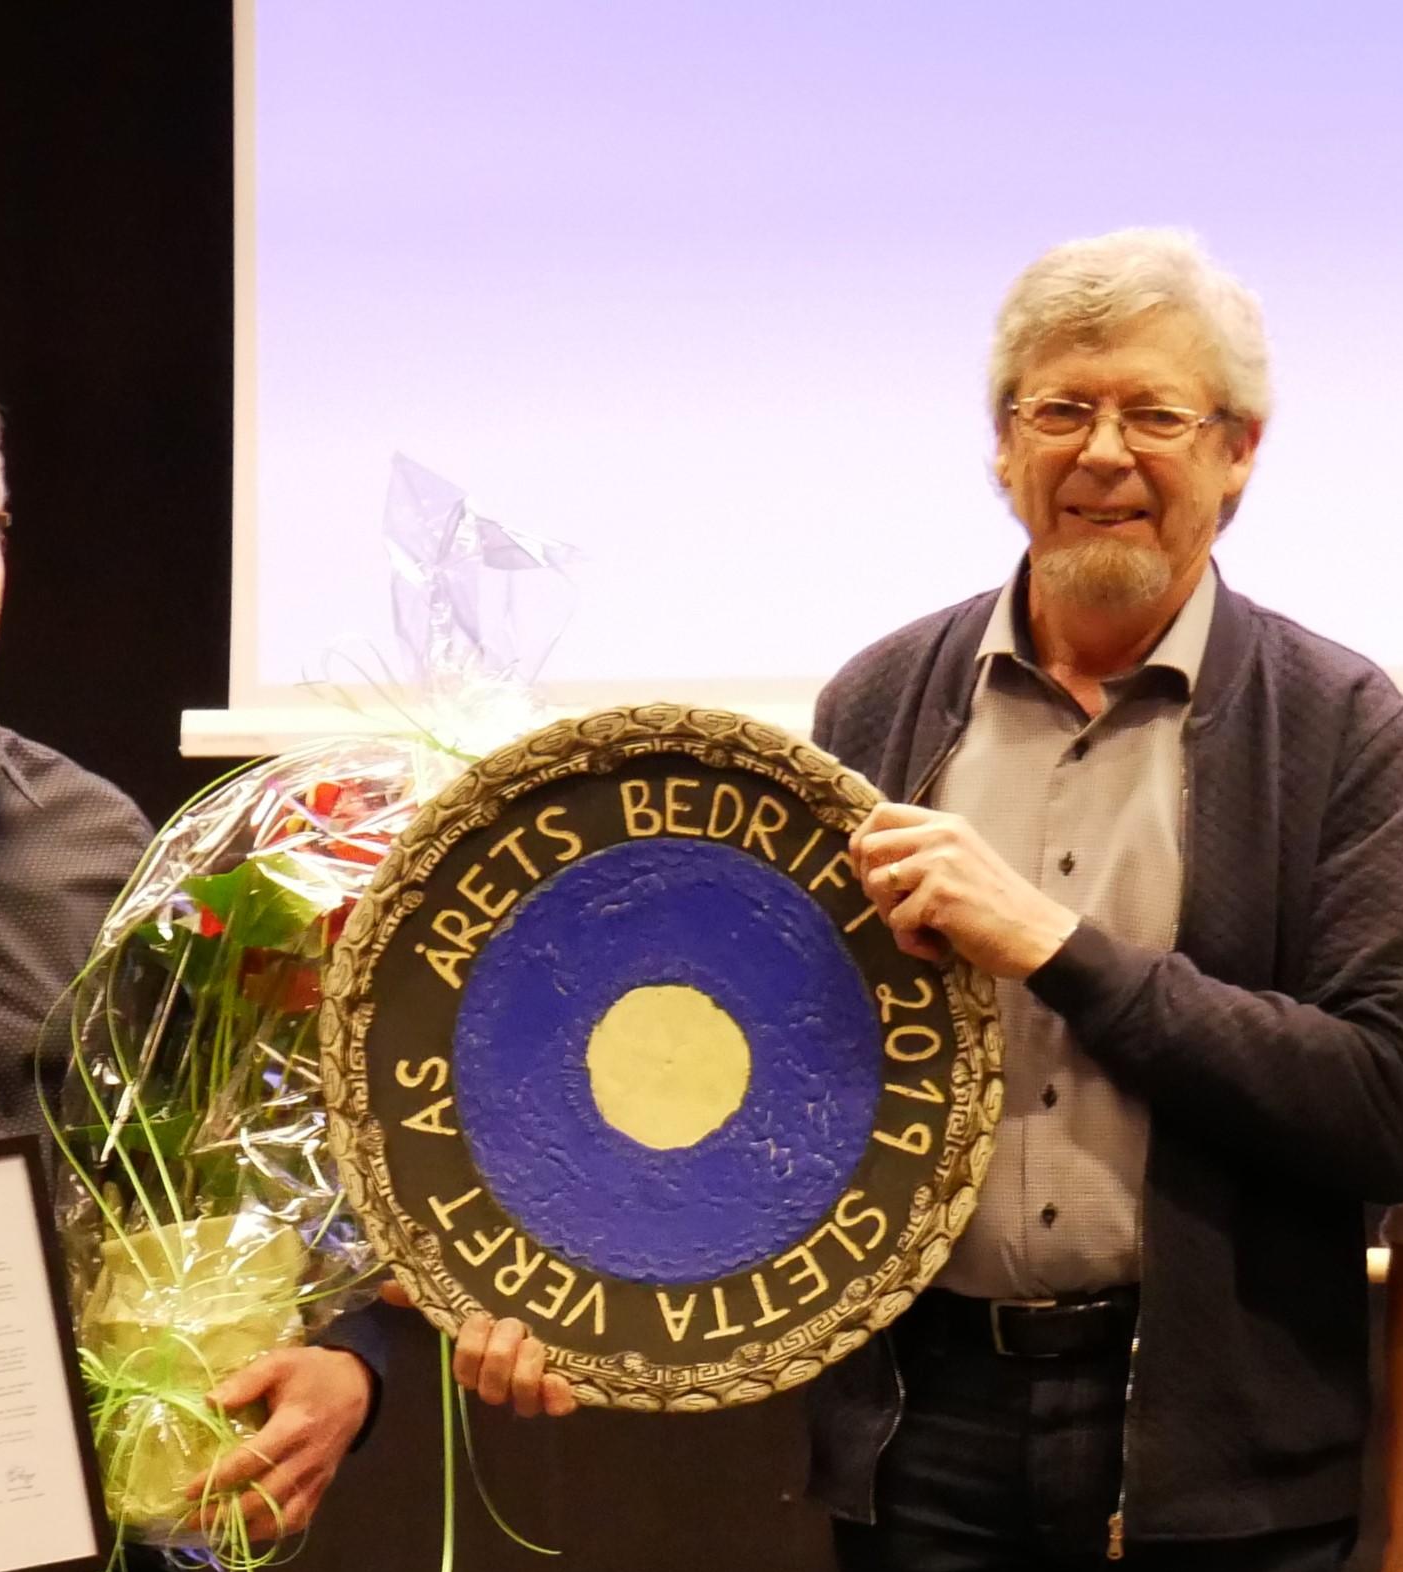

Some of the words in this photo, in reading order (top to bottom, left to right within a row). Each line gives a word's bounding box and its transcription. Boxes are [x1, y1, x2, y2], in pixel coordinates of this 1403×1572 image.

[414, 805, 583, 990] ÅRETS
[394, 1055, 459, 1137] AS
[872, 978, 943, 1156] 2019
[427, 1186, 607, 1337] VERFT
[655, 1188, 888, 1343] SLETTA
